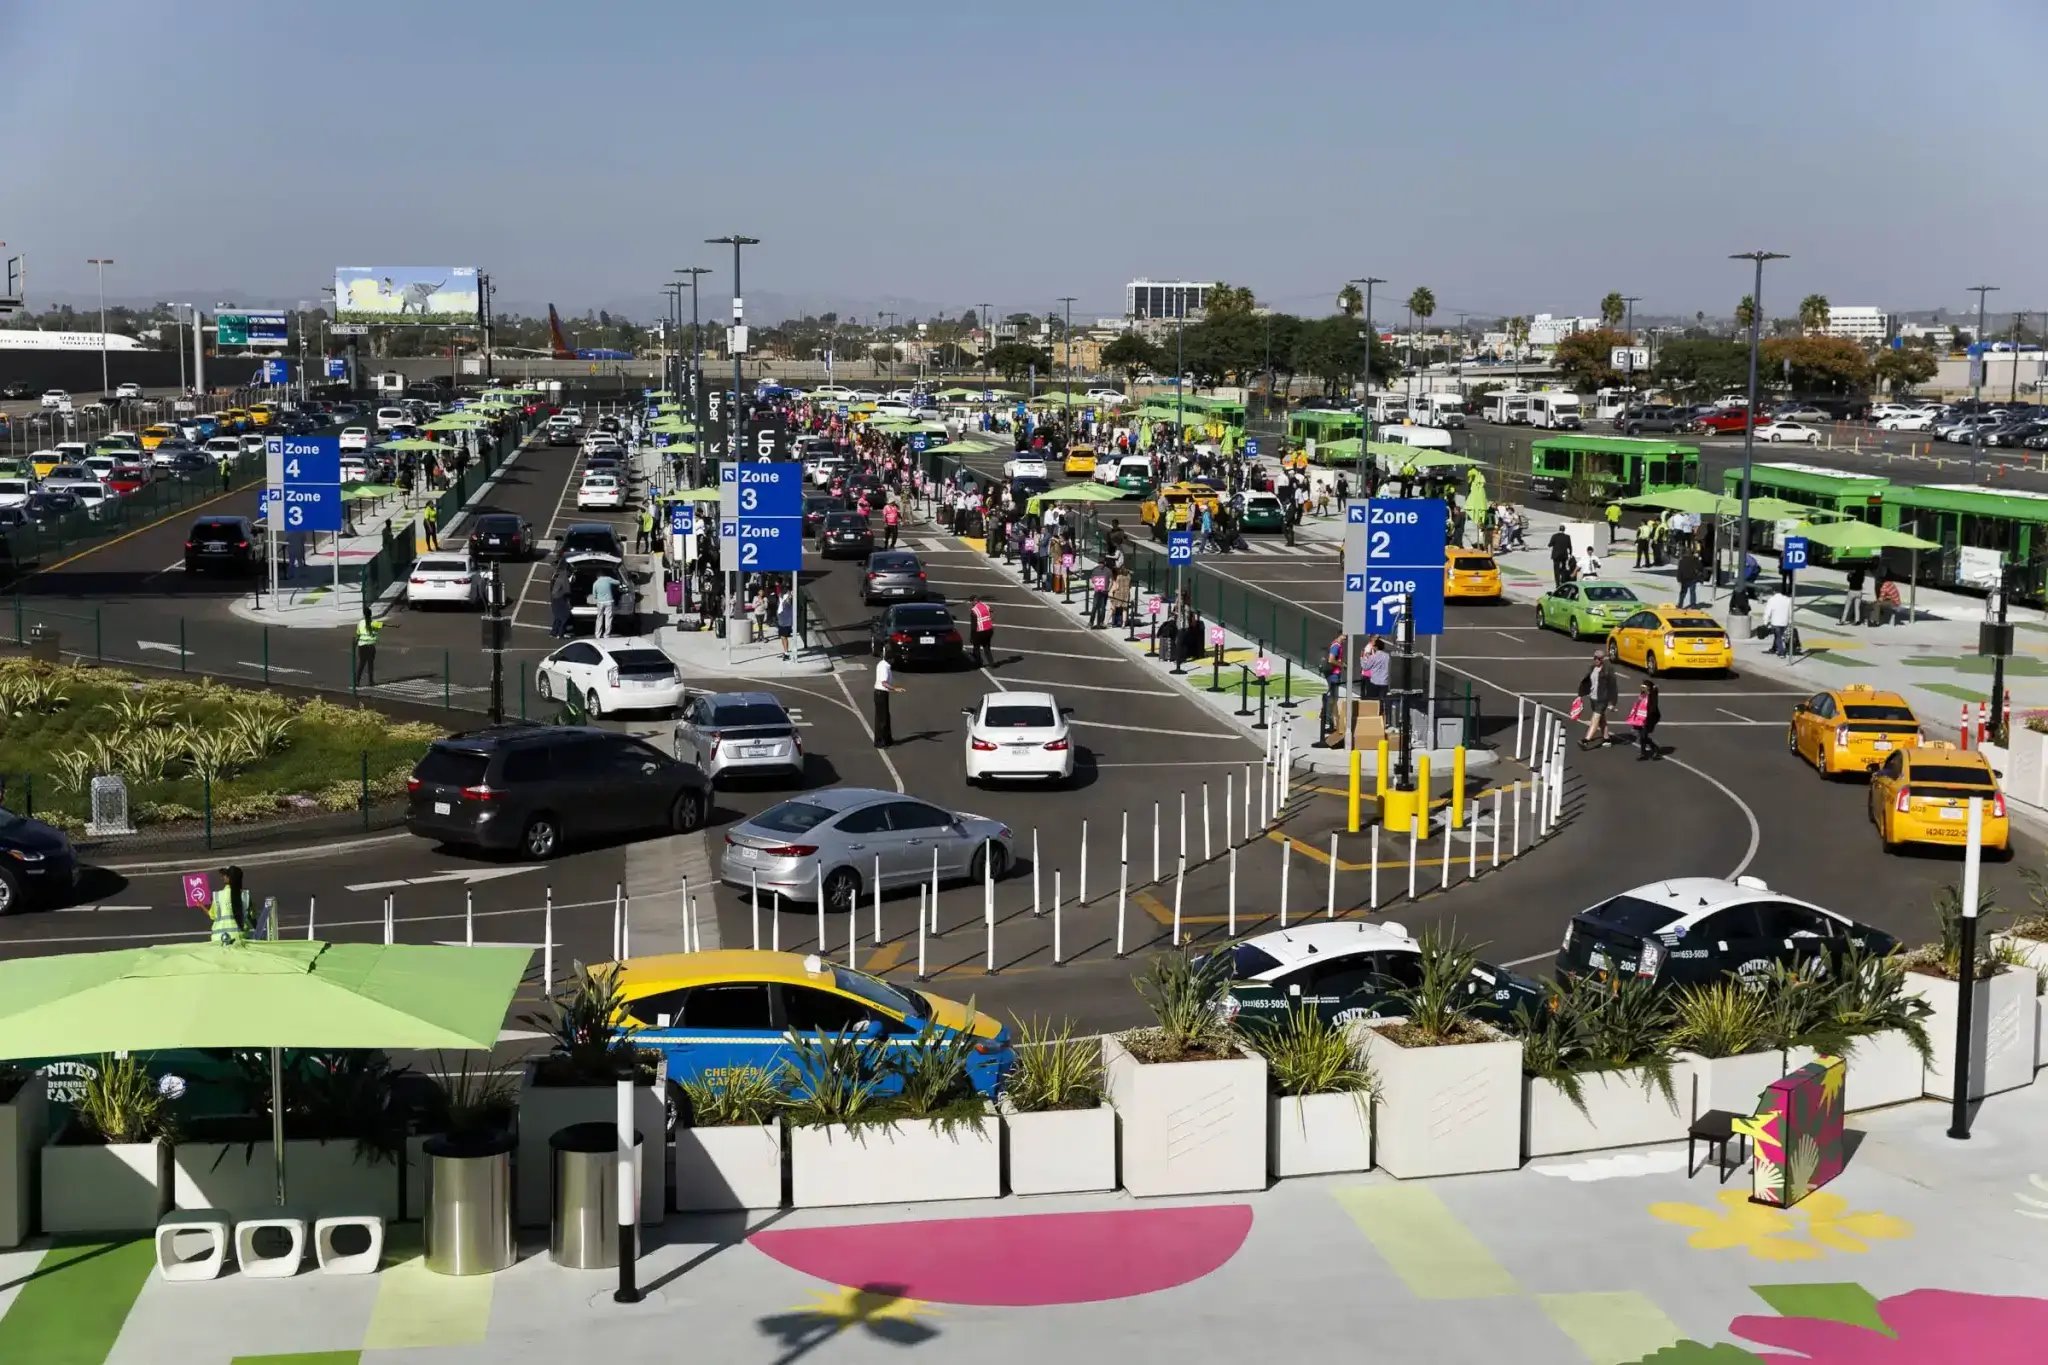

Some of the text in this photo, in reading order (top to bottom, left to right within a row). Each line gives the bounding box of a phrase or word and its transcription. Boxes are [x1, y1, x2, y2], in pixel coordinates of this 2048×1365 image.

[1617, 351, 1643, 364] Eit
[709, 391, 720, 423] Uber
[285, 443, 320, 455] Zone
[758, 429, 775, 464] Ube
[914, 441, 925, 449] 2C
[1246, 446, 1257, 454] 1C
[285, 459, 301, 478] 4
[741, 470, 780, 483] Zone
[286, 490, 321, 502] Zone
[741, 488, 758, 510] 3
[288, 506, 303, 526] 3
[1370, 508, 1418, 524] Zone
[673, 518, 692, 530] 3D
[741, 524, 780, 538] Zone
[1370, 531, 1391, 558] 2
[741, 543, 758, 565] 2
[1170, 546, 1191, 559] 2D
[1786, 550, 1806, 563] 1D
[1369, 577, 1416, 593] Zone
[1212, 630, 1224, 639] 24
[1257, 661, 1269, 670] 24
[1620, 960, 1636, 972] 205
